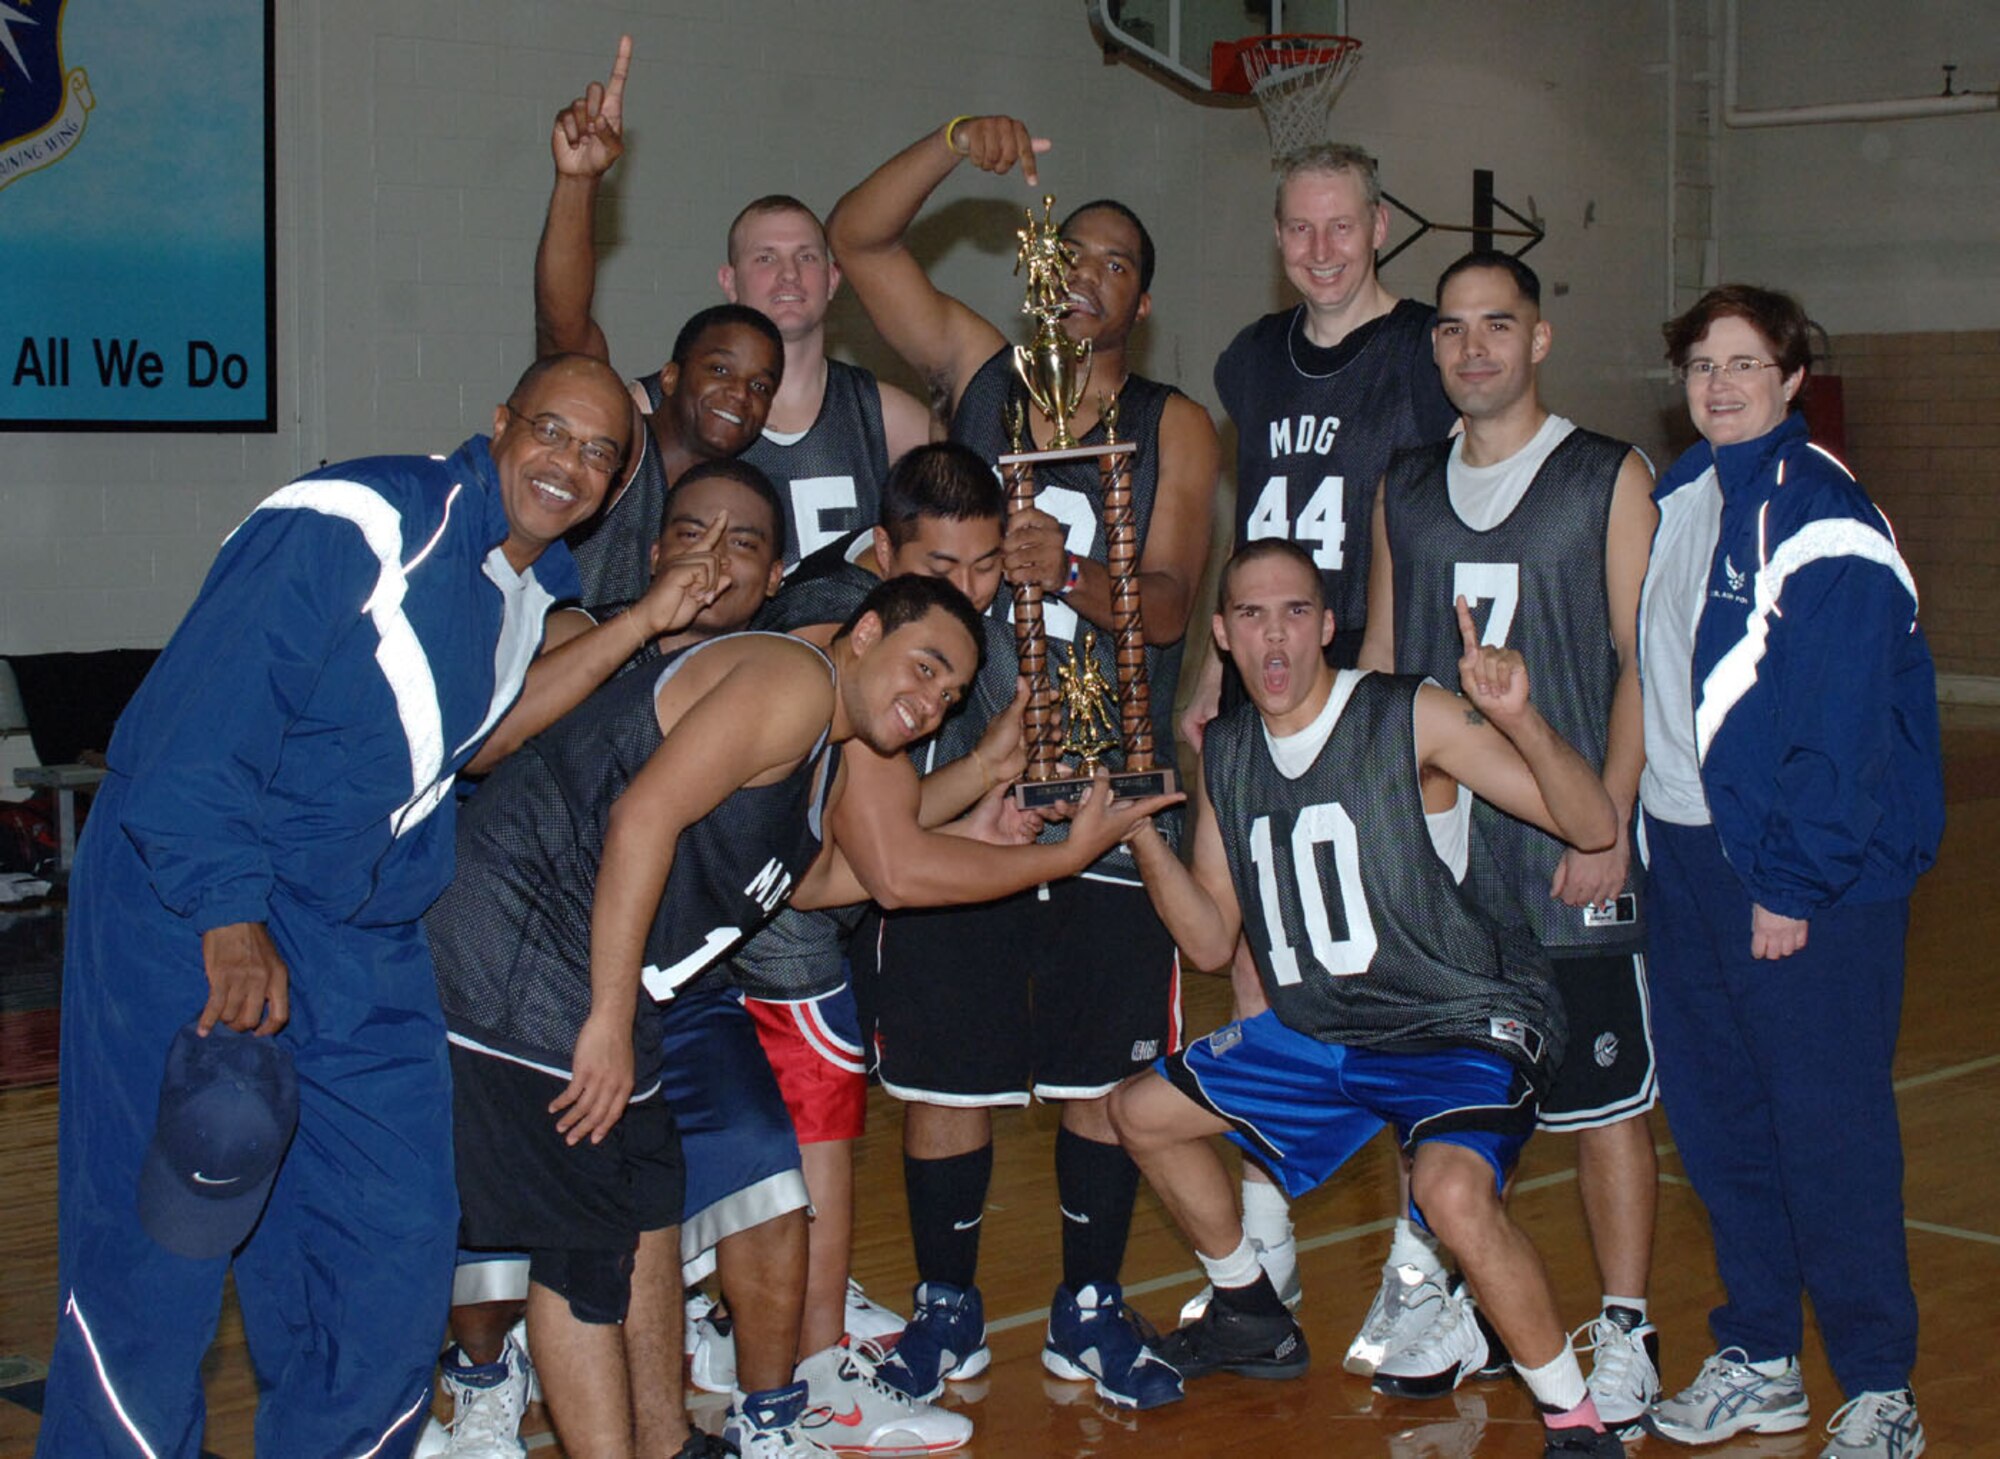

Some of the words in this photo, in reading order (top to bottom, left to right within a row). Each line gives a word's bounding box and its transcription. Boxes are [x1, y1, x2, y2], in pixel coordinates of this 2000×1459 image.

[44, 118, 79, 153] WING
[12, 336, 70, 387] All
[93, 338, 164, 388] We
[187, 340, 248, 390] Do
[1269, 415, 1342, 459] MDG
[1247, 475, 1347, 571] 44
[1453, 562, 1519, 649] 7
[1250, 802, 1378, 987] 10
[641, 927, 743, 1001] 1
